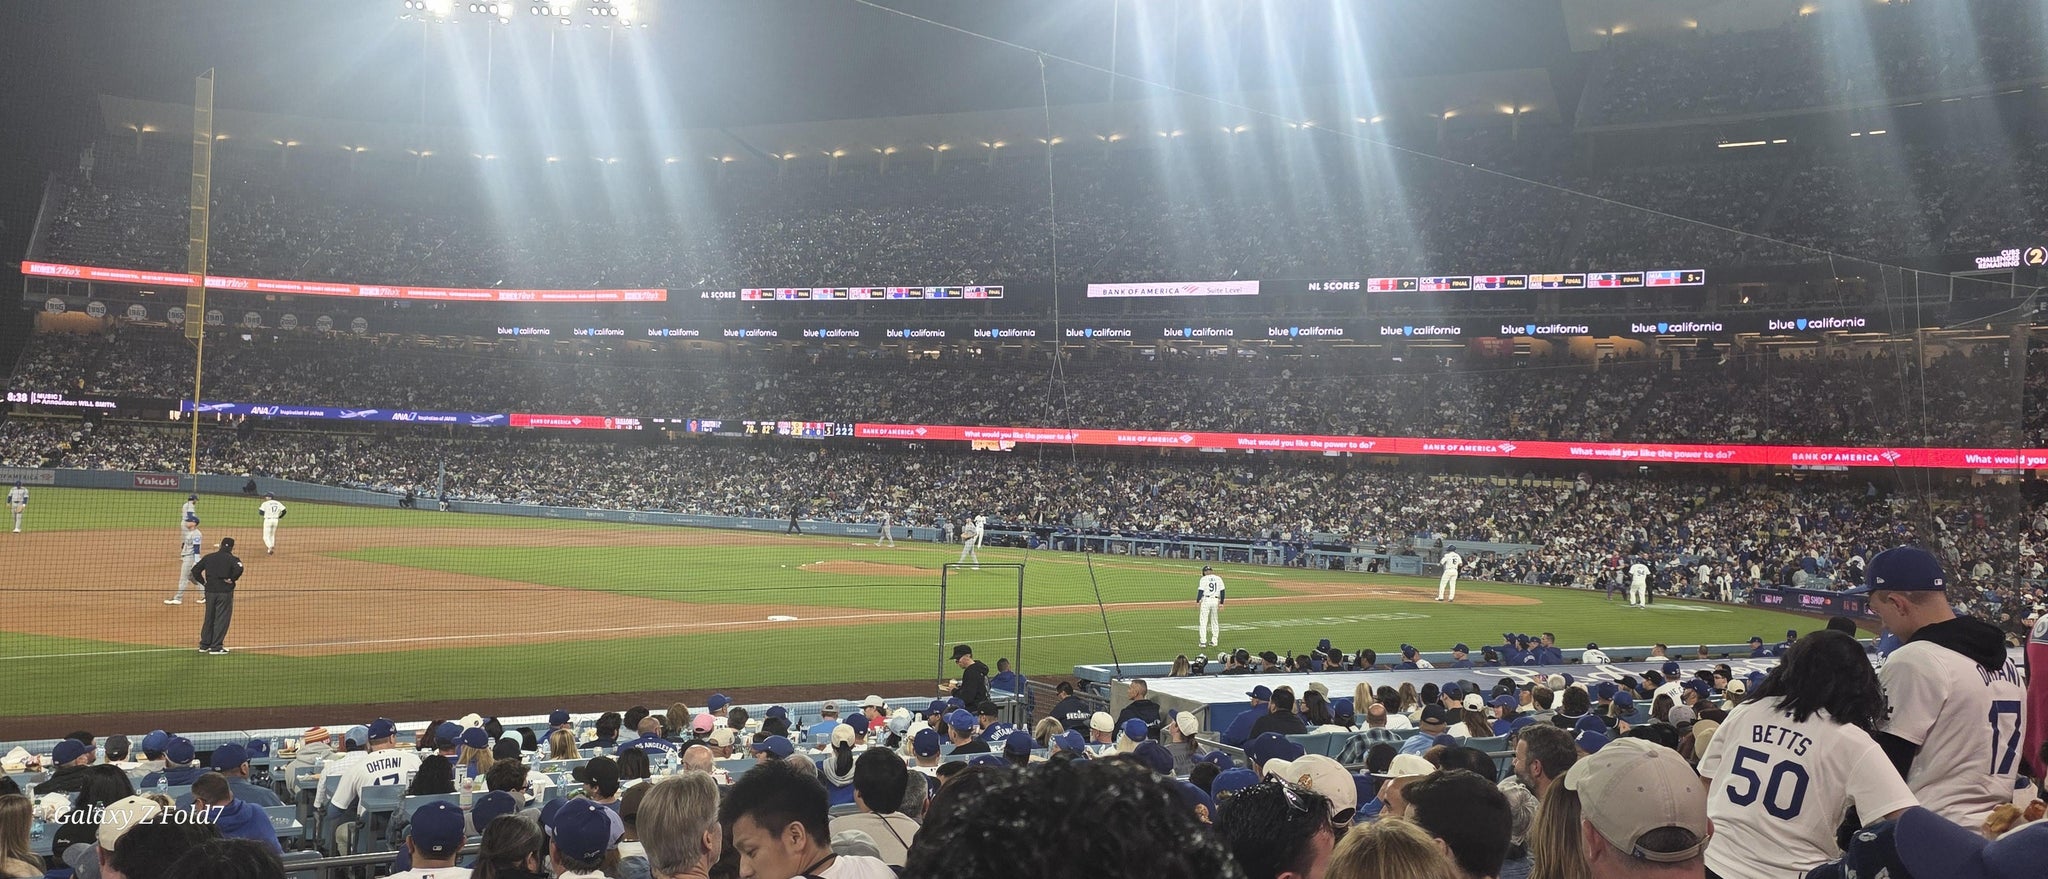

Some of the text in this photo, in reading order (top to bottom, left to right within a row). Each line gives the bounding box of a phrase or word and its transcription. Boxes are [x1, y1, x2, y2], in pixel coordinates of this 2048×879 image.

[1976, 254, 2020, 264] CHALLENGES
[1978, 261, 2020, 269] REMAINING
[1324, 282, 1360, 290] SCORES
[1632, 322, 1722, 333] blue california
[1769, 317, 1865, 330] blue california
[648, 328, 699, 336] blue california
[804, 329, 859, 337] blue california
[887, 329, 945, 337] blue california
[974, 329, 1035, 337] blue california
[1066, 328, 1131, 337] blue california
[1164, 328, 1233, 336] blue california
[1269, 327, 1343, 335] blue california
[1381, 326, 1460, 335] blue california
[1502, 324, 1588, 334] blue california
[7, 392, 28, 402] 8:38
[251, 406, 268, 414] ANA
[1570, 447, 1594, 456] What
[1595, 448, 1621, 456] would
[1622, 450, 1638, 458] you
[1640, 449, 1657, 457] like
[1658, 450, 1673, 458] the
[1674, 451, 1702, 459] power
[1966, 454, 2047, 466] What would you
[1209, 582, 1216, 592] 91
[1772, 595, 1783, 604] APP
[1811, 596, 1824, 605] SHOP
[1752, 724, 1813, 757] BETTS
[1989, 700, 2021, 774] 17
[366, 757, 401, 774] OHTANI
[1726, 746, 1810, 821] 50
